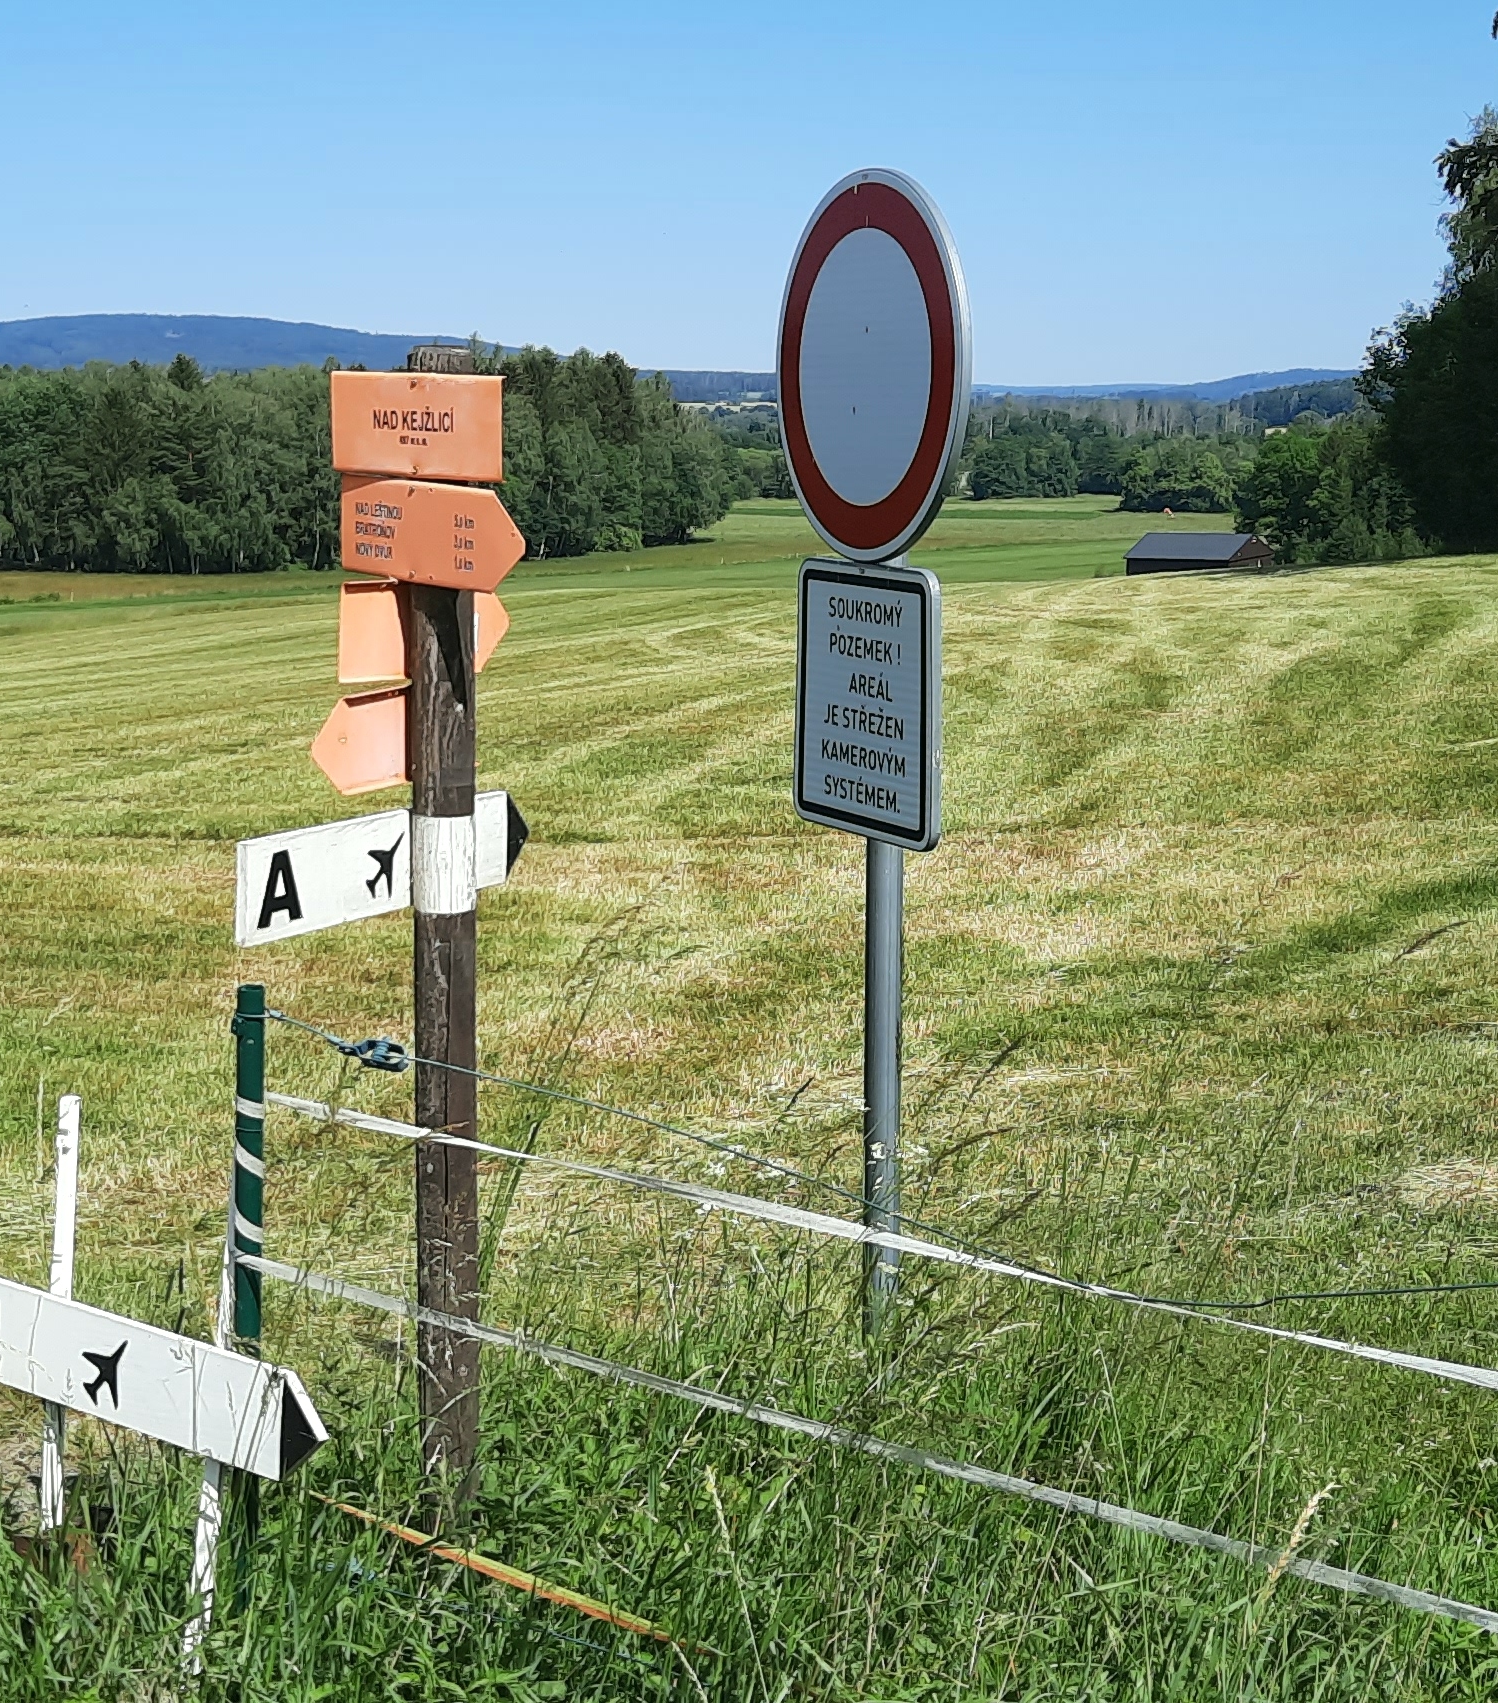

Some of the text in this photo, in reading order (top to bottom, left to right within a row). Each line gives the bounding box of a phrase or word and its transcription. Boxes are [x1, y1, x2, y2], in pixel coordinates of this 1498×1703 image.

[373, 406, 454, 432] NAD KEJŽLICÍ
[355, 502, 369, 515] NAD
[828, 596, 903, 627] SOUKROMÝ
[848, 672, 893, 702] AREÁL
[824, 703, 904, 740] JE STŘEŽEN
[821, 738, 906, 778] KAMEROVÝM
[824, 774, 901, 814] SYSTÉMEM.
[256, 849, 303, 930] A
